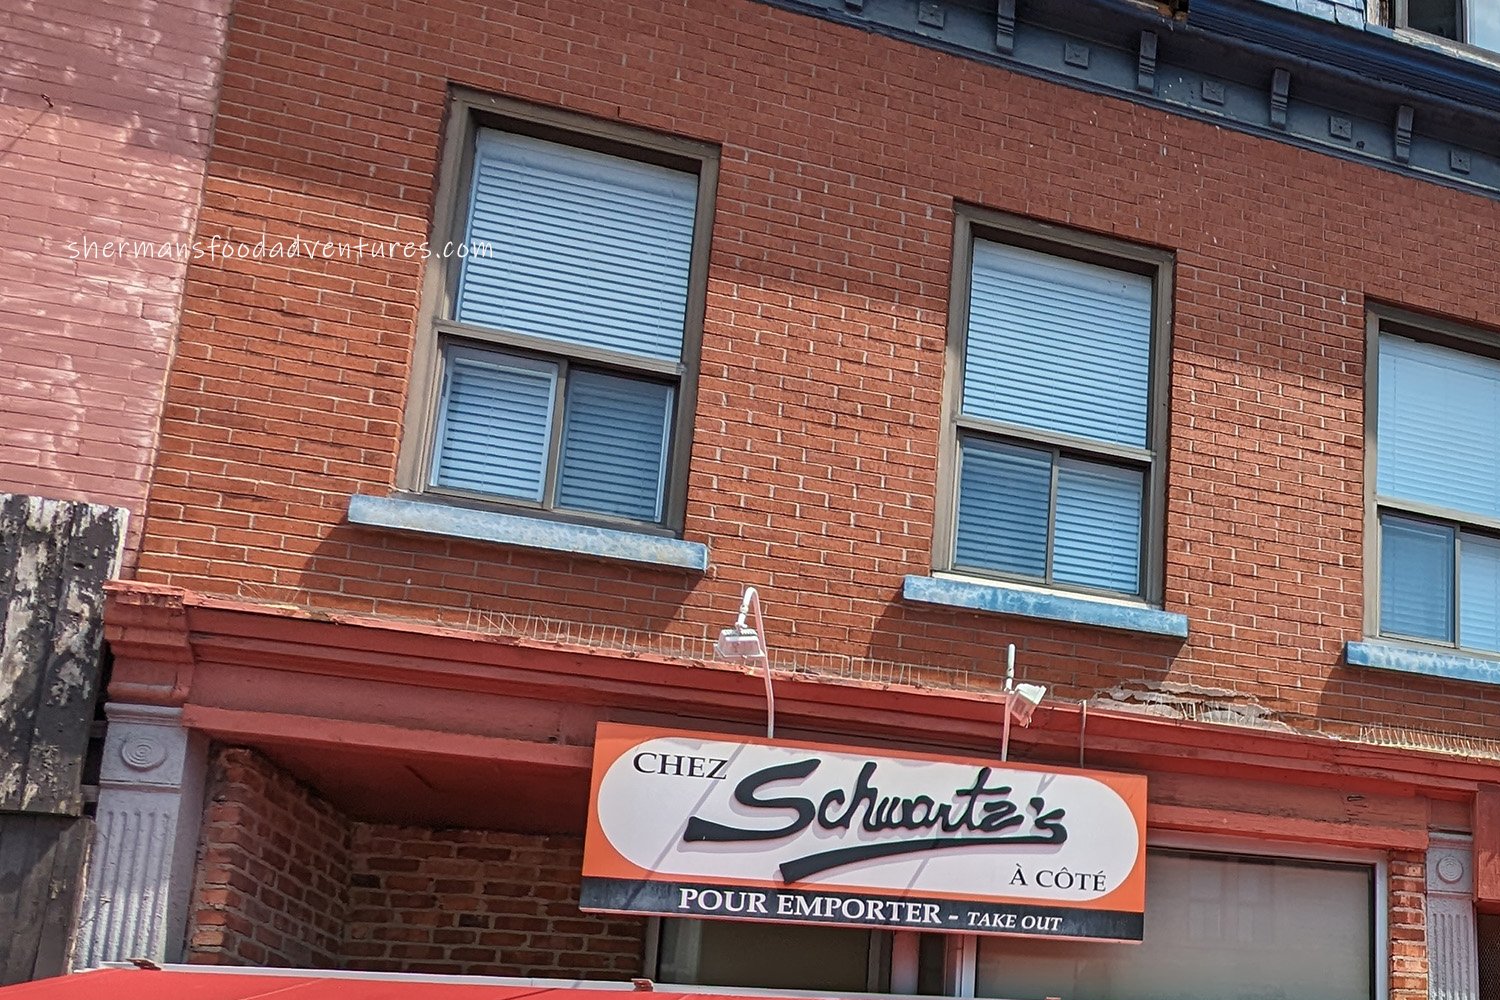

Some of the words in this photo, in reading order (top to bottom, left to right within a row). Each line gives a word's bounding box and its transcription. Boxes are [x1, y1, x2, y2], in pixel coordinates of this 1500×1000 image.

[633, 752, 728, 780] CHEZ
[683, 758, 1068, 883] Schwartz's
[1009, 863, 1028, 886] À
[1035, 867, 1107, 891] CÔTÉ
[679, 888, 768, 913] POUR
[776, 895, 942, 924] EMPORTER
[967, 911, 1017, 929] TAKE
[1021, 914, 1063, 931] OUT
